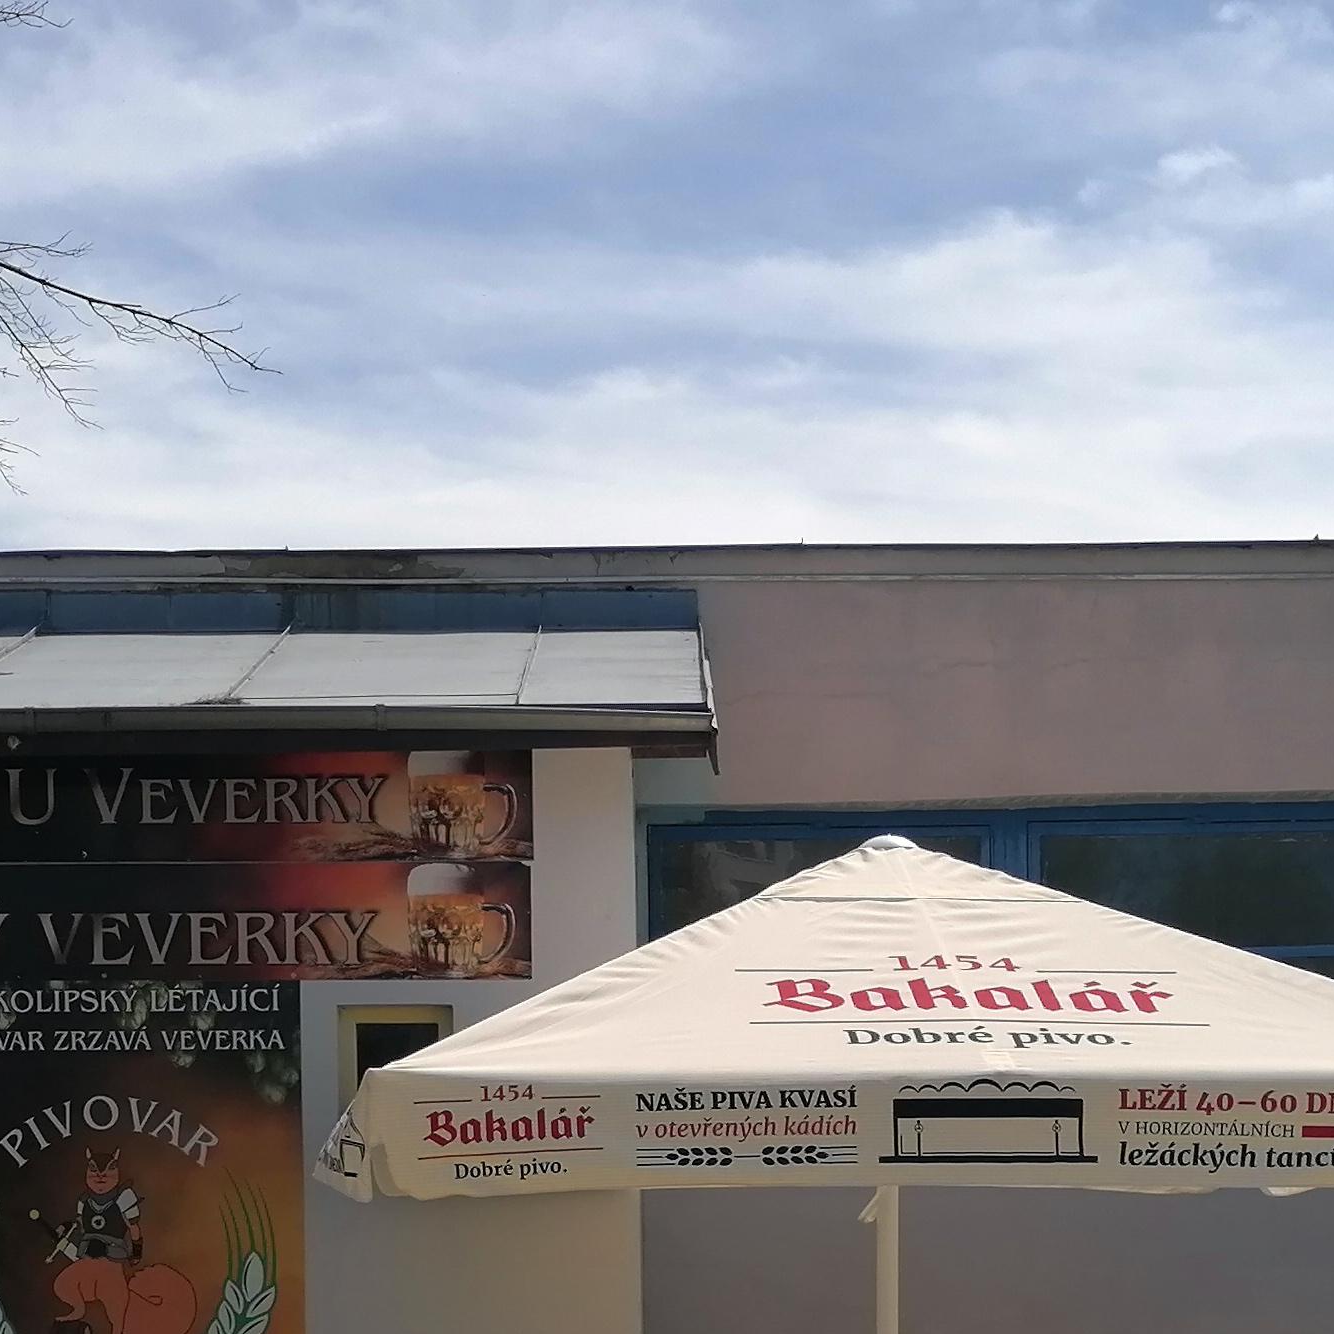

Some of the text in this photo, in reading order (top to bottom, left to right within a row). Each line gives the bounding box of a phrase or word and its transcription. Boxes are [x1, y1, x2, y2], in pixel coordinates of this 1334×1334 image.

[4, 768, 57, 825] U
[38, 912, 378, 967] VEVERKY
[888, 955, 1021, 972] 1454
[150, 983, 281, 1013] LÉTAJÍCÍ
[762, 978, 1174, 1014] Bakalář
[53, 1027, 152, 1051] ZRZAVÁ
[162, 1029, 286, 1050] VEVERKA
[843, 1026, 1132, 1049] Dobré pivo.
[480, 1084, 534, 1102] 1454
[635, 1086, 857, 1112] NAŠE PIVA KVASÍ
[1118, 1083, 1187, 1113] LEŽÍ
[423, 1105, 596, 1148] Bakalář
[636, 1112, 857, 1144] v otevřených kádích
[1118, 1118, 1296, 1138] V HORIZONTÁLNÍCH
[454, 1157, 568, 1181] Dobré pivo.
[1118, 1142, 1257, 1170] ležáckých
